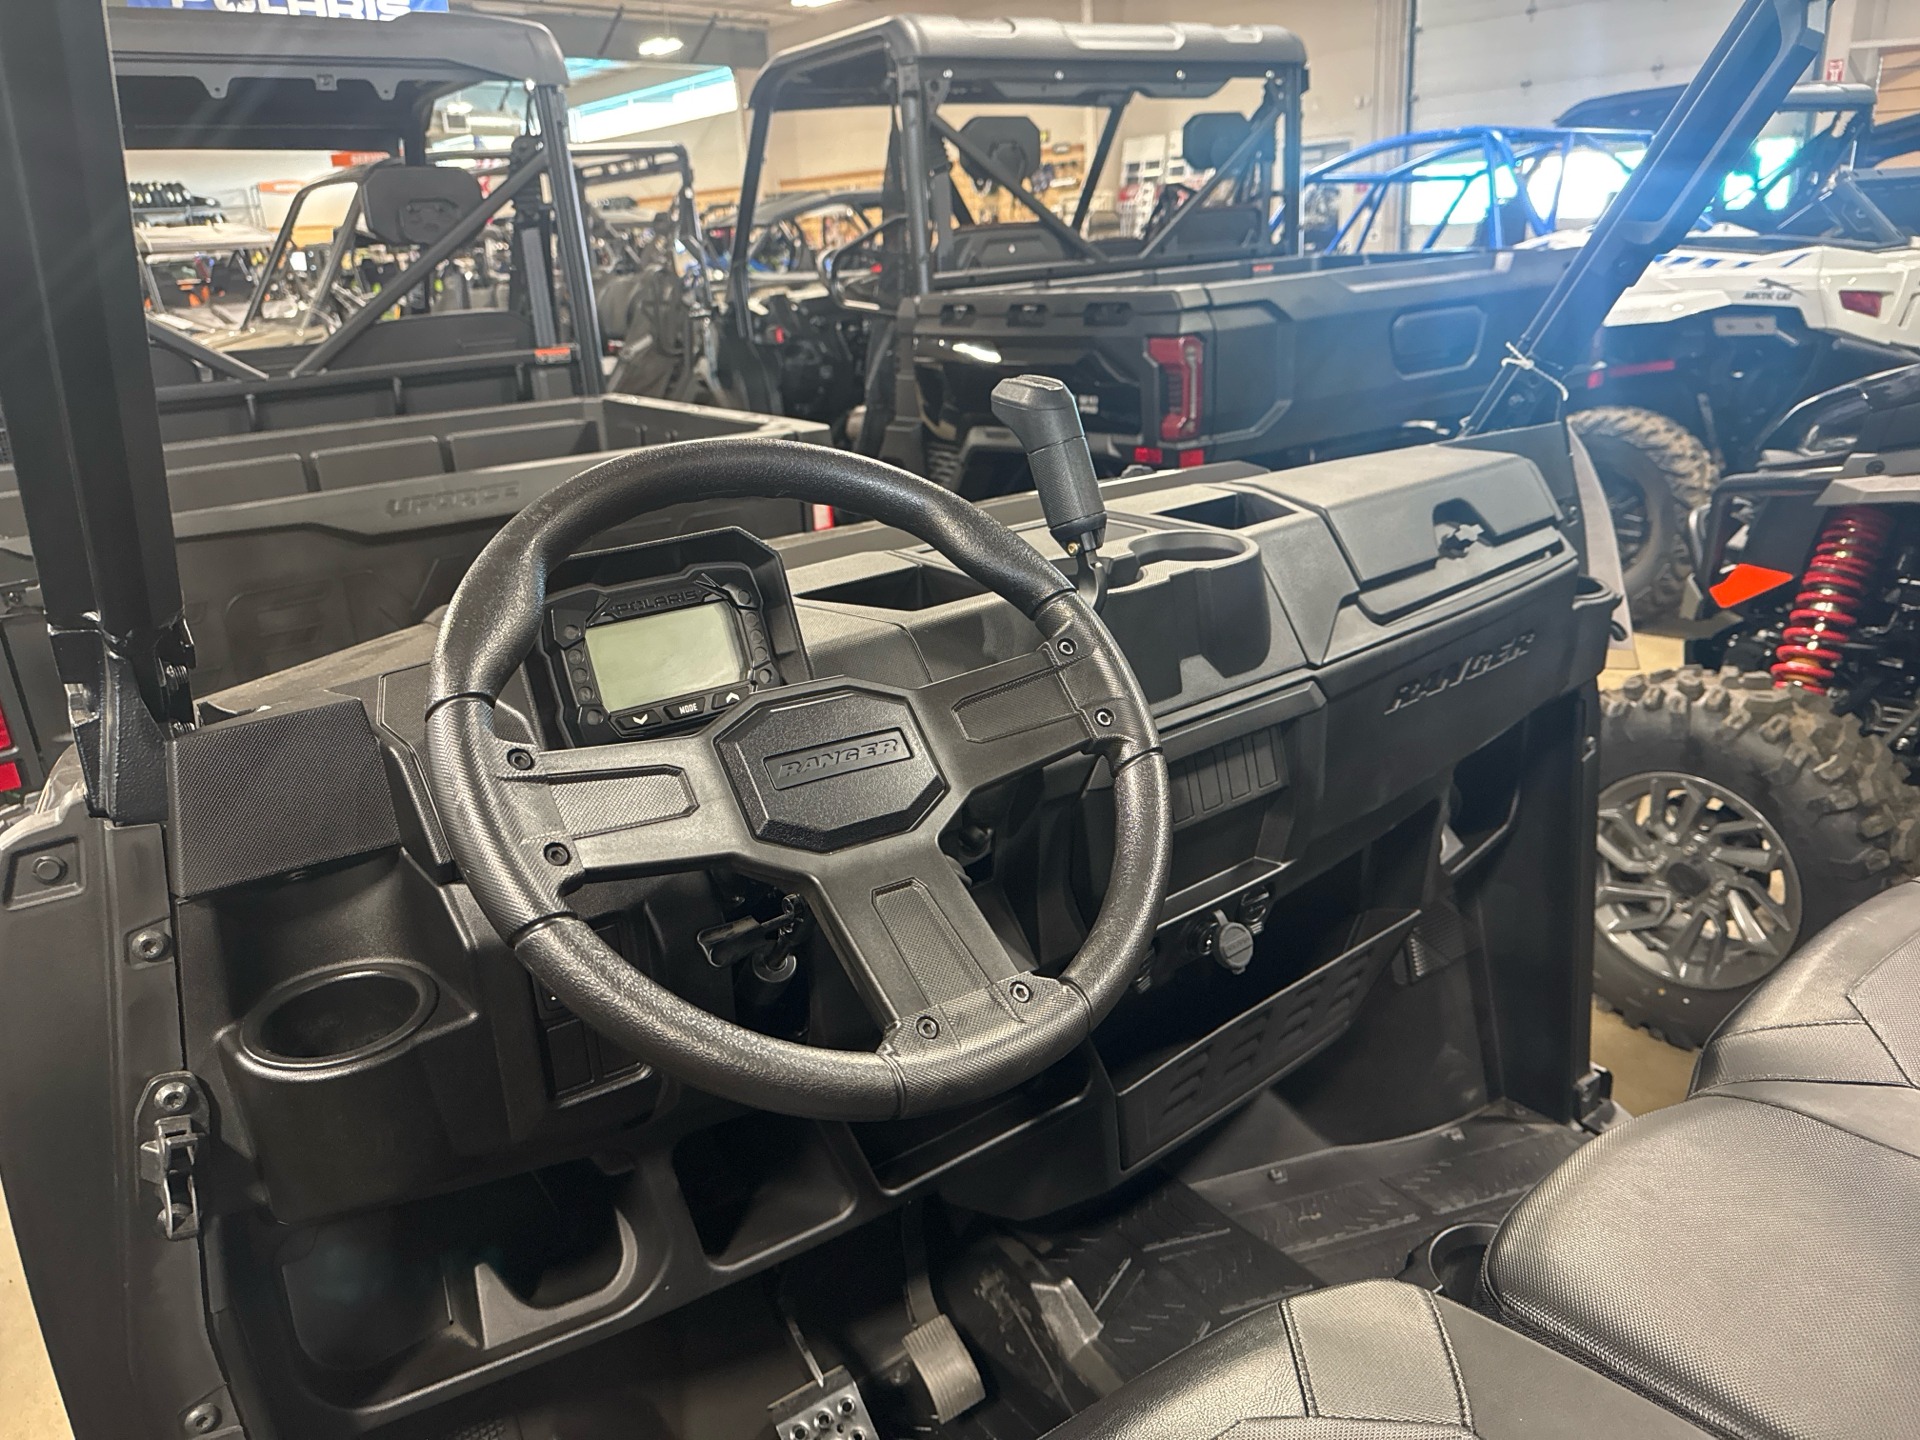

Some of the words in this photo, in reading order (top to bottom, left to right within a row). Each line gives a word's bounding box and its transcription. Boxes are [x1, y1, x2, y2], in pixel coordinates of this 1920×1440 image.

[616, 590, 698, 615] POLARIS
[1384, 629, 1535, 716] RANGER
[679, 702, 698, 715] MODE
[778, 738, 899, 779] RANGER
